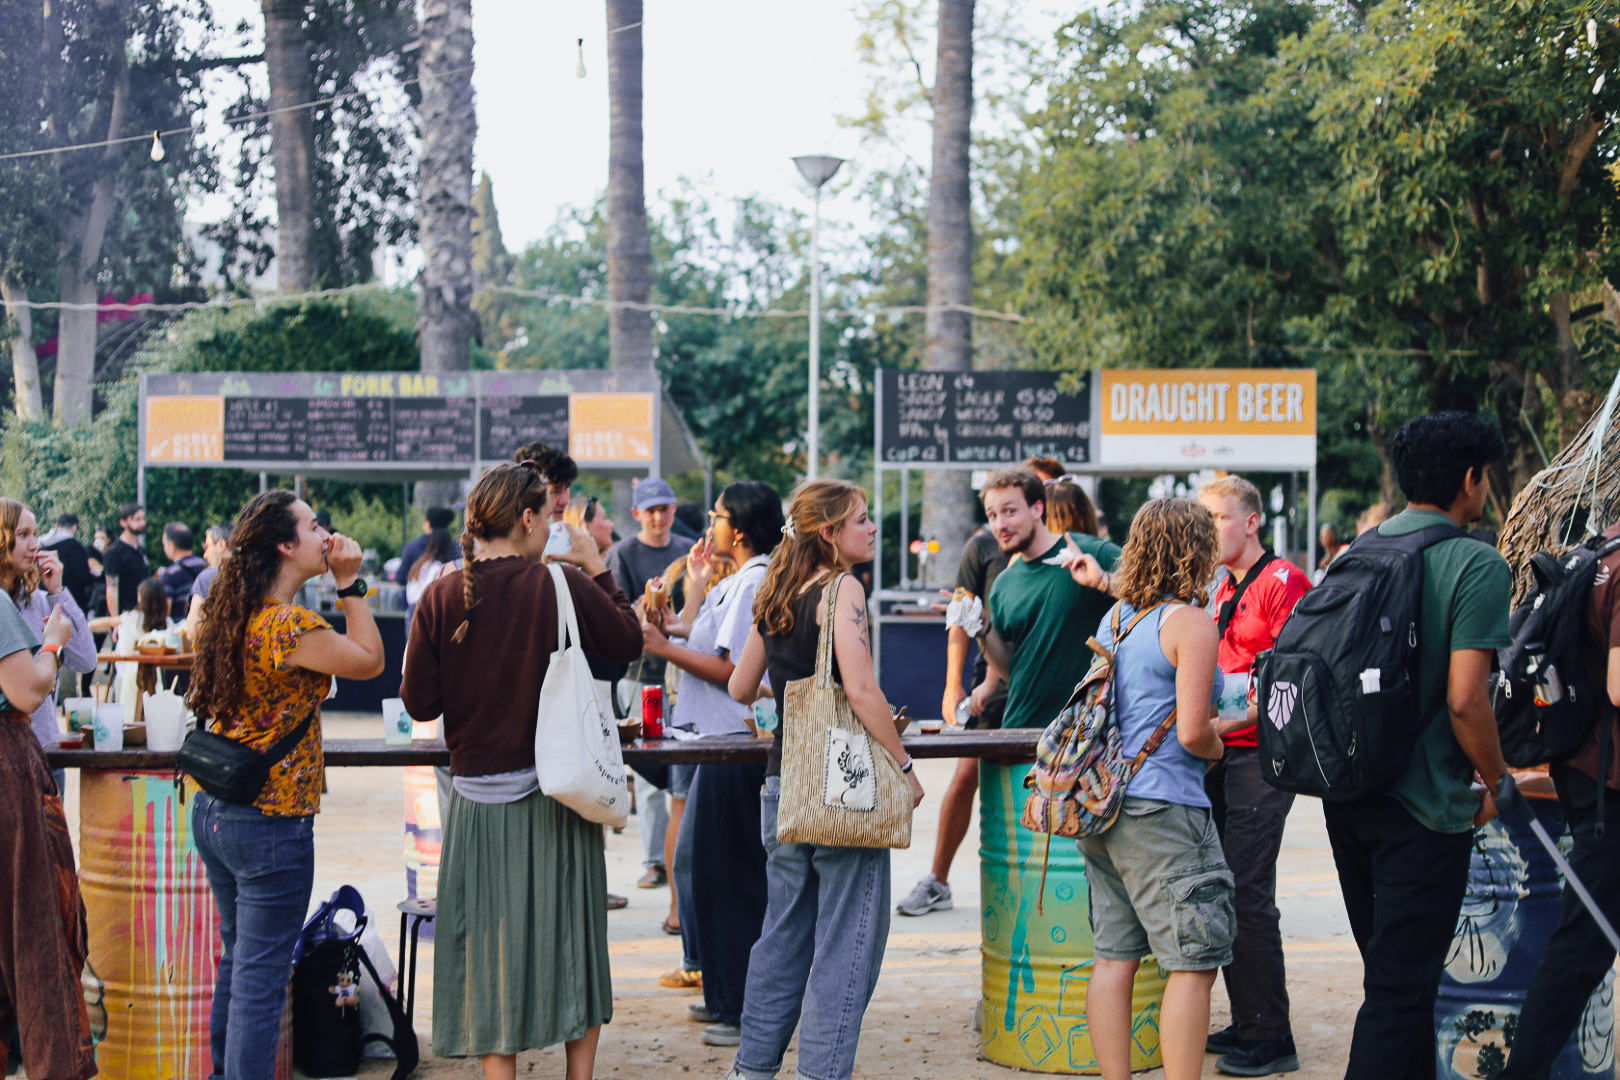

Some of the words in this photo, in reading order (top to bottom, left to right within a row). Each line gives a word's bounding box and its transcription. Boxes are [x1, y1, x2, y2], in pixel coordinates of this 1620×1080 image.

[341, 375, 394, 397] FORK
[399, 375, 439, 396] BAR
[898, 374, 944, 390] LEON
[1111, 382, 1231, 422] DRAUGHT
[1238, 382, 1305, 422] BEER
